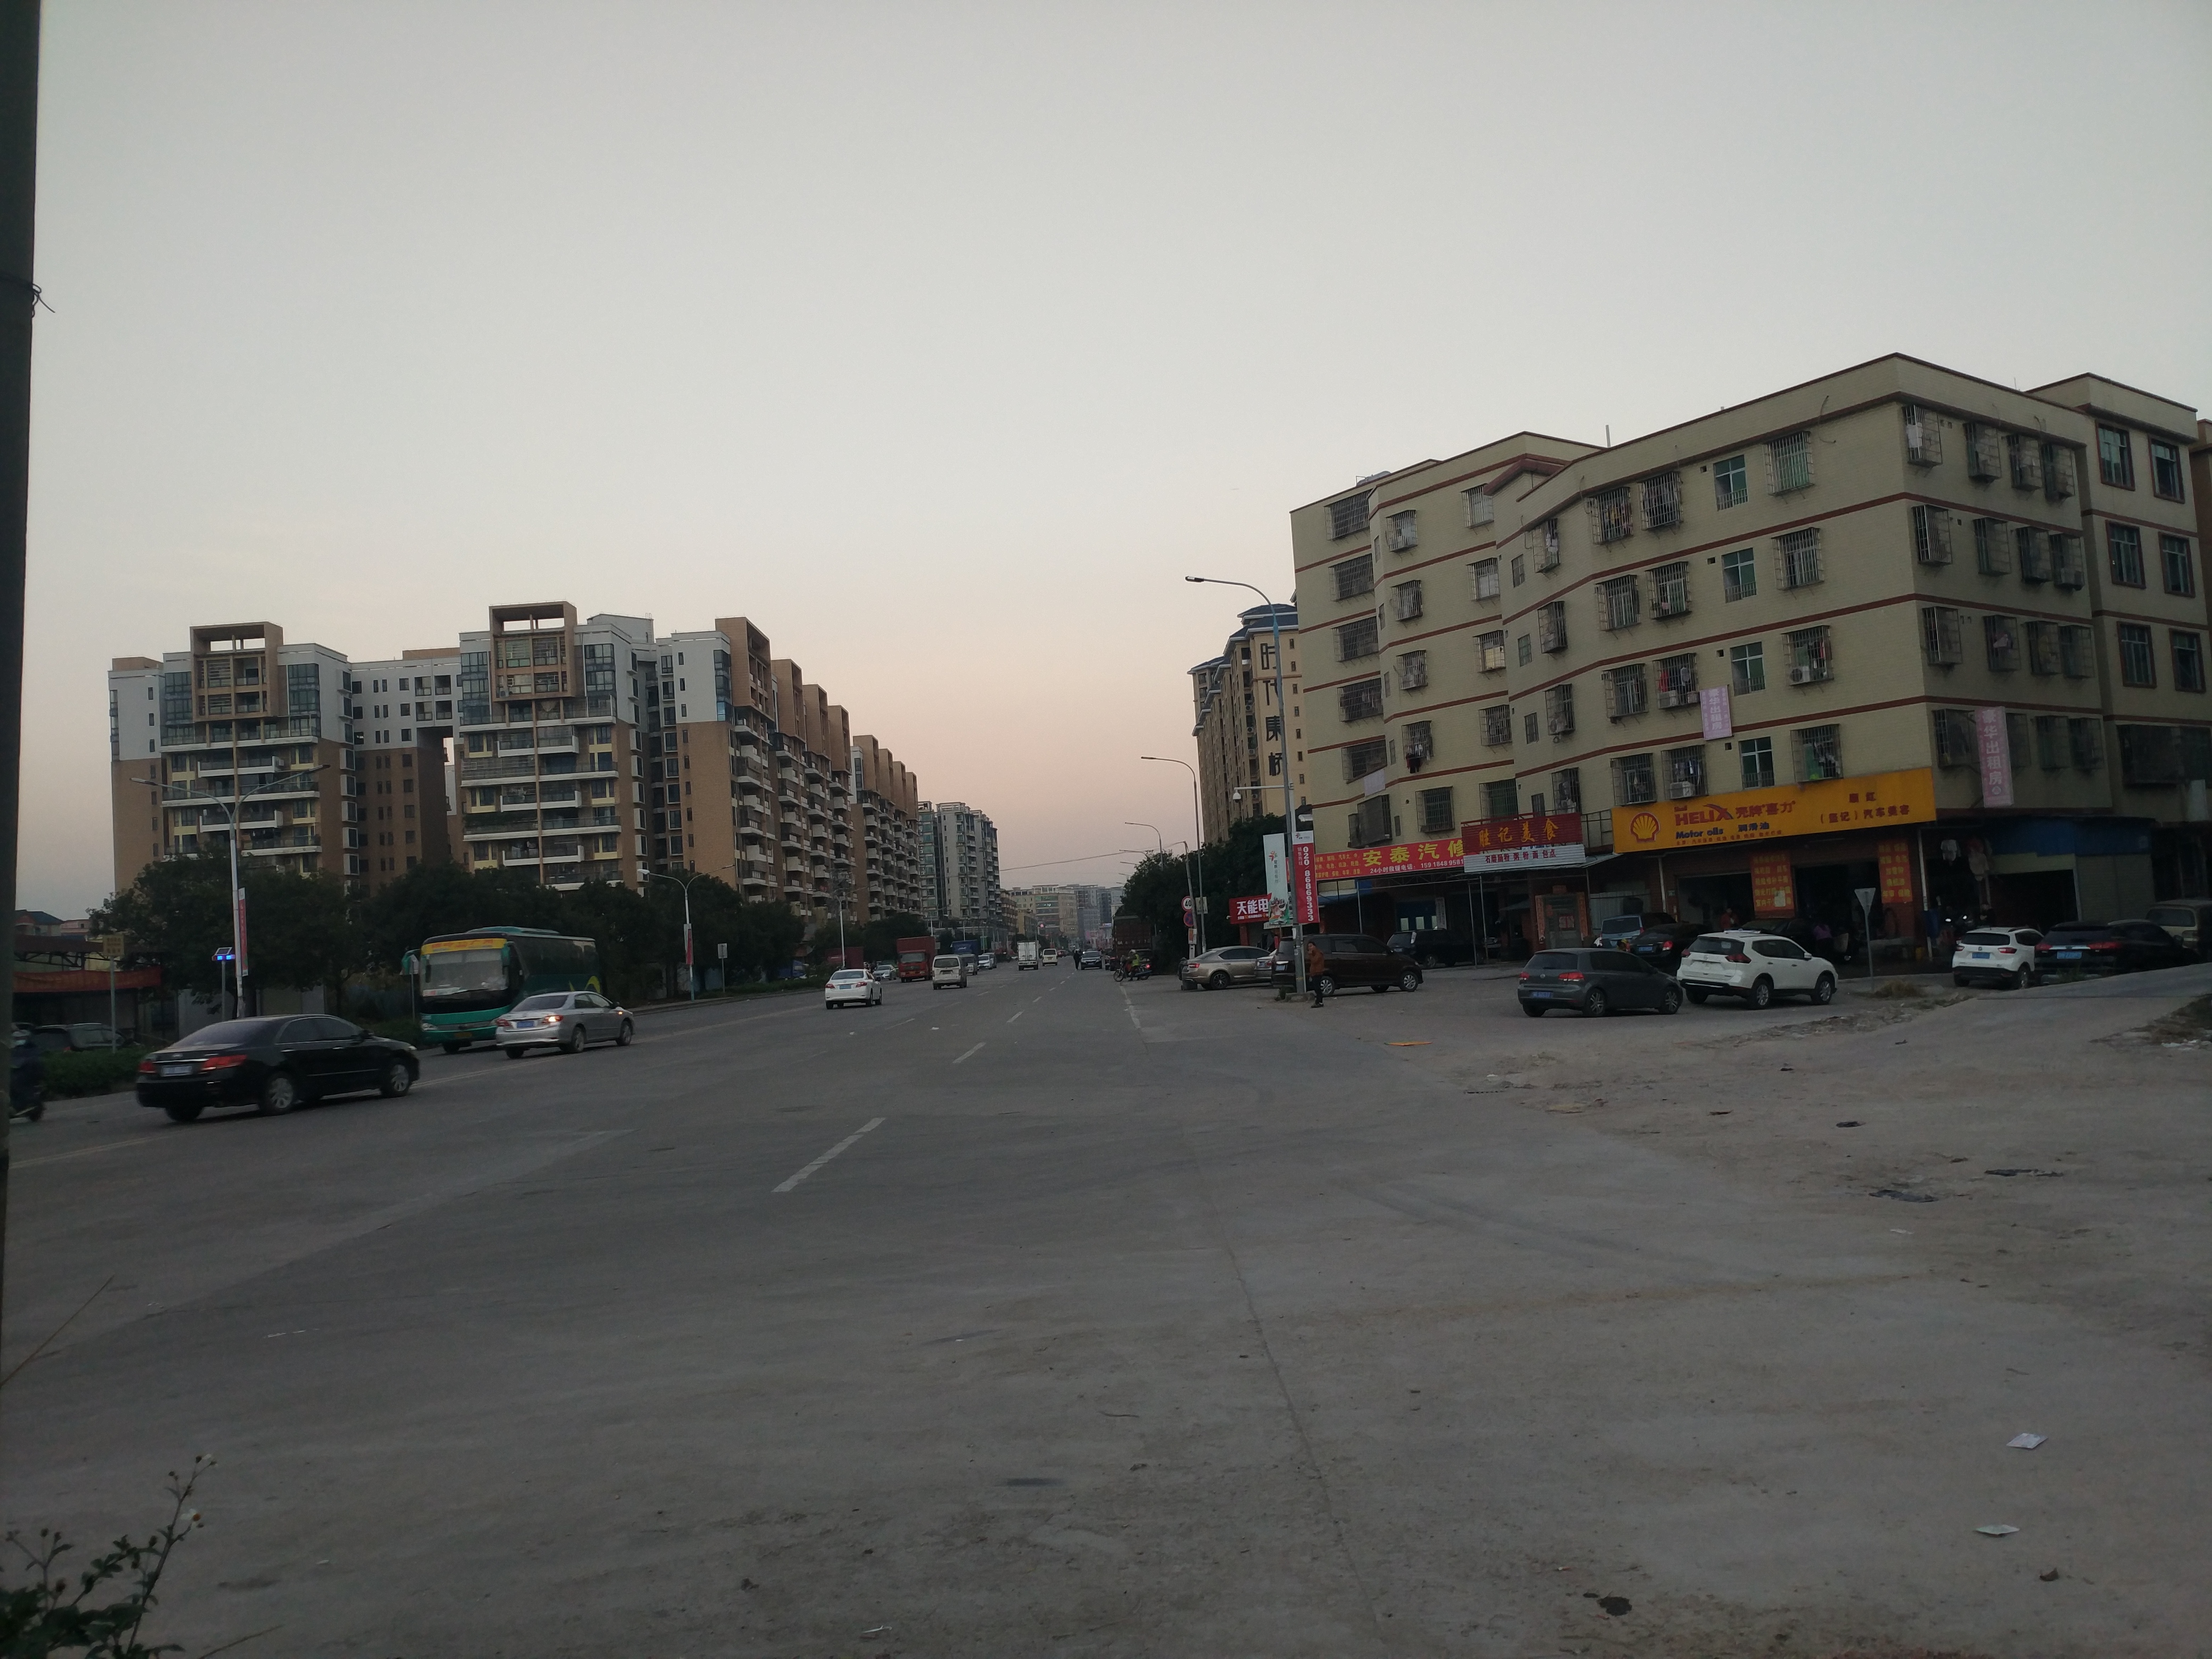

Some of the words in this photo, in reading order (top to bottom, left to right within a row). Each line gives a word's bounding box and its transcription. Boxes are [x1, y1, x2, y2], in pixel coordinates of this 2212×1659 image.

[1675, 803, 1733, 826] HELIX
[1676, 830, 1703, 839] Motor
[1706, 827, 1723, 836] oils
